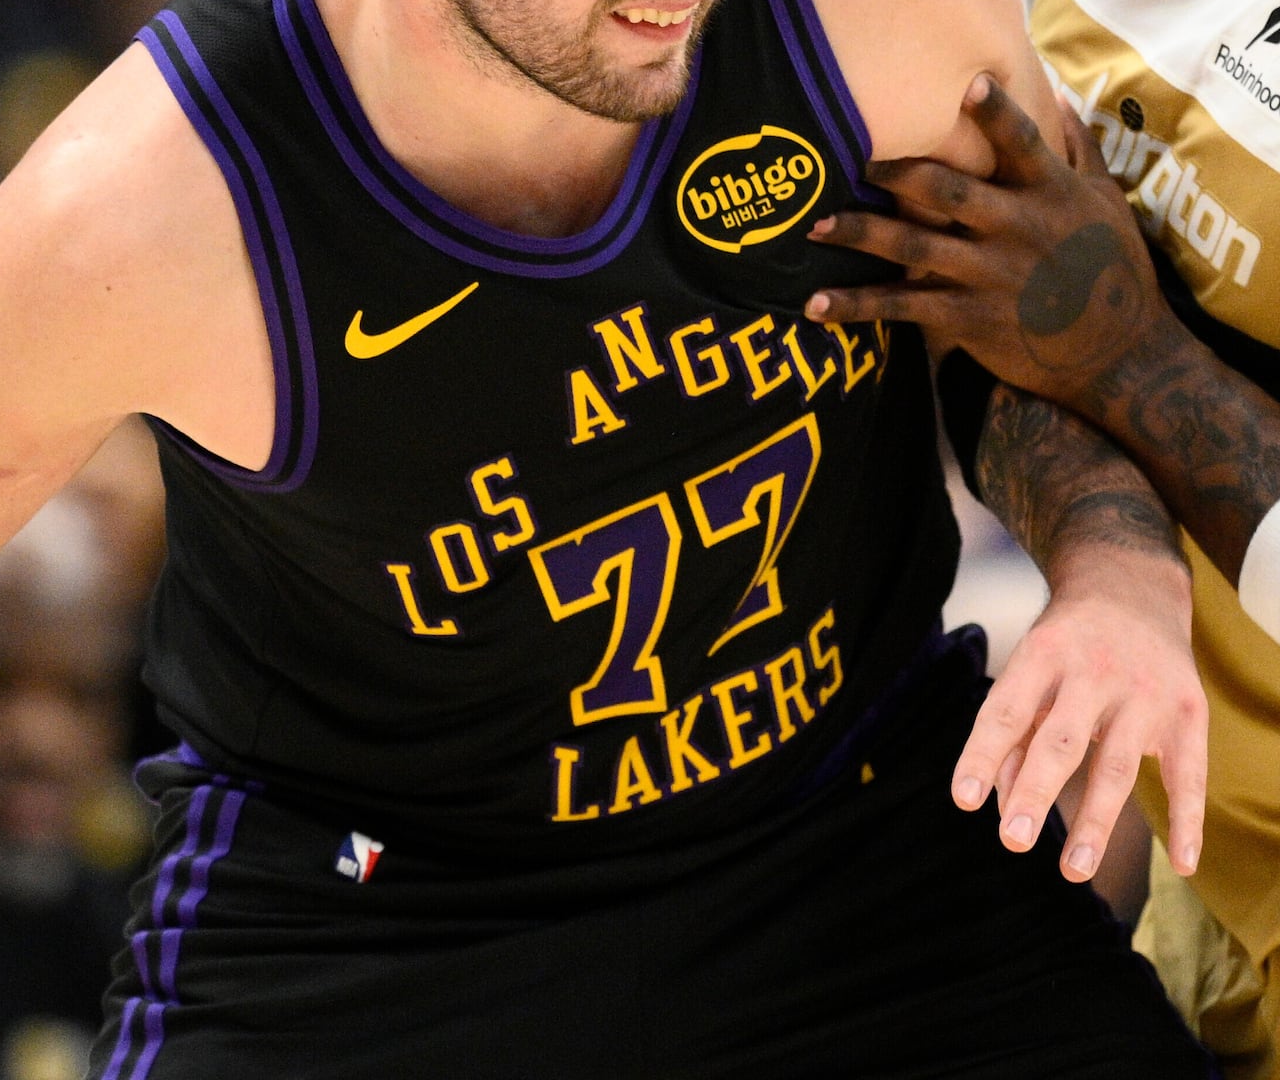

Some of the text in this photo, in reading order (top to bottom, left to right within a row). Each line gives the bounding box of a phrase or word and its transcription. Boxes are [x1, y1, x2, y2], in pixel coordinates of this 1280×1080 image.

[686, 153, 814, 221] bibigo
[721, 197, 776, 230] 비비고
[384, 304, 891, 638] LOS ANGELE
[525, 410, 824, 728] 77
[550, 607, 844, 823] LAKERS
